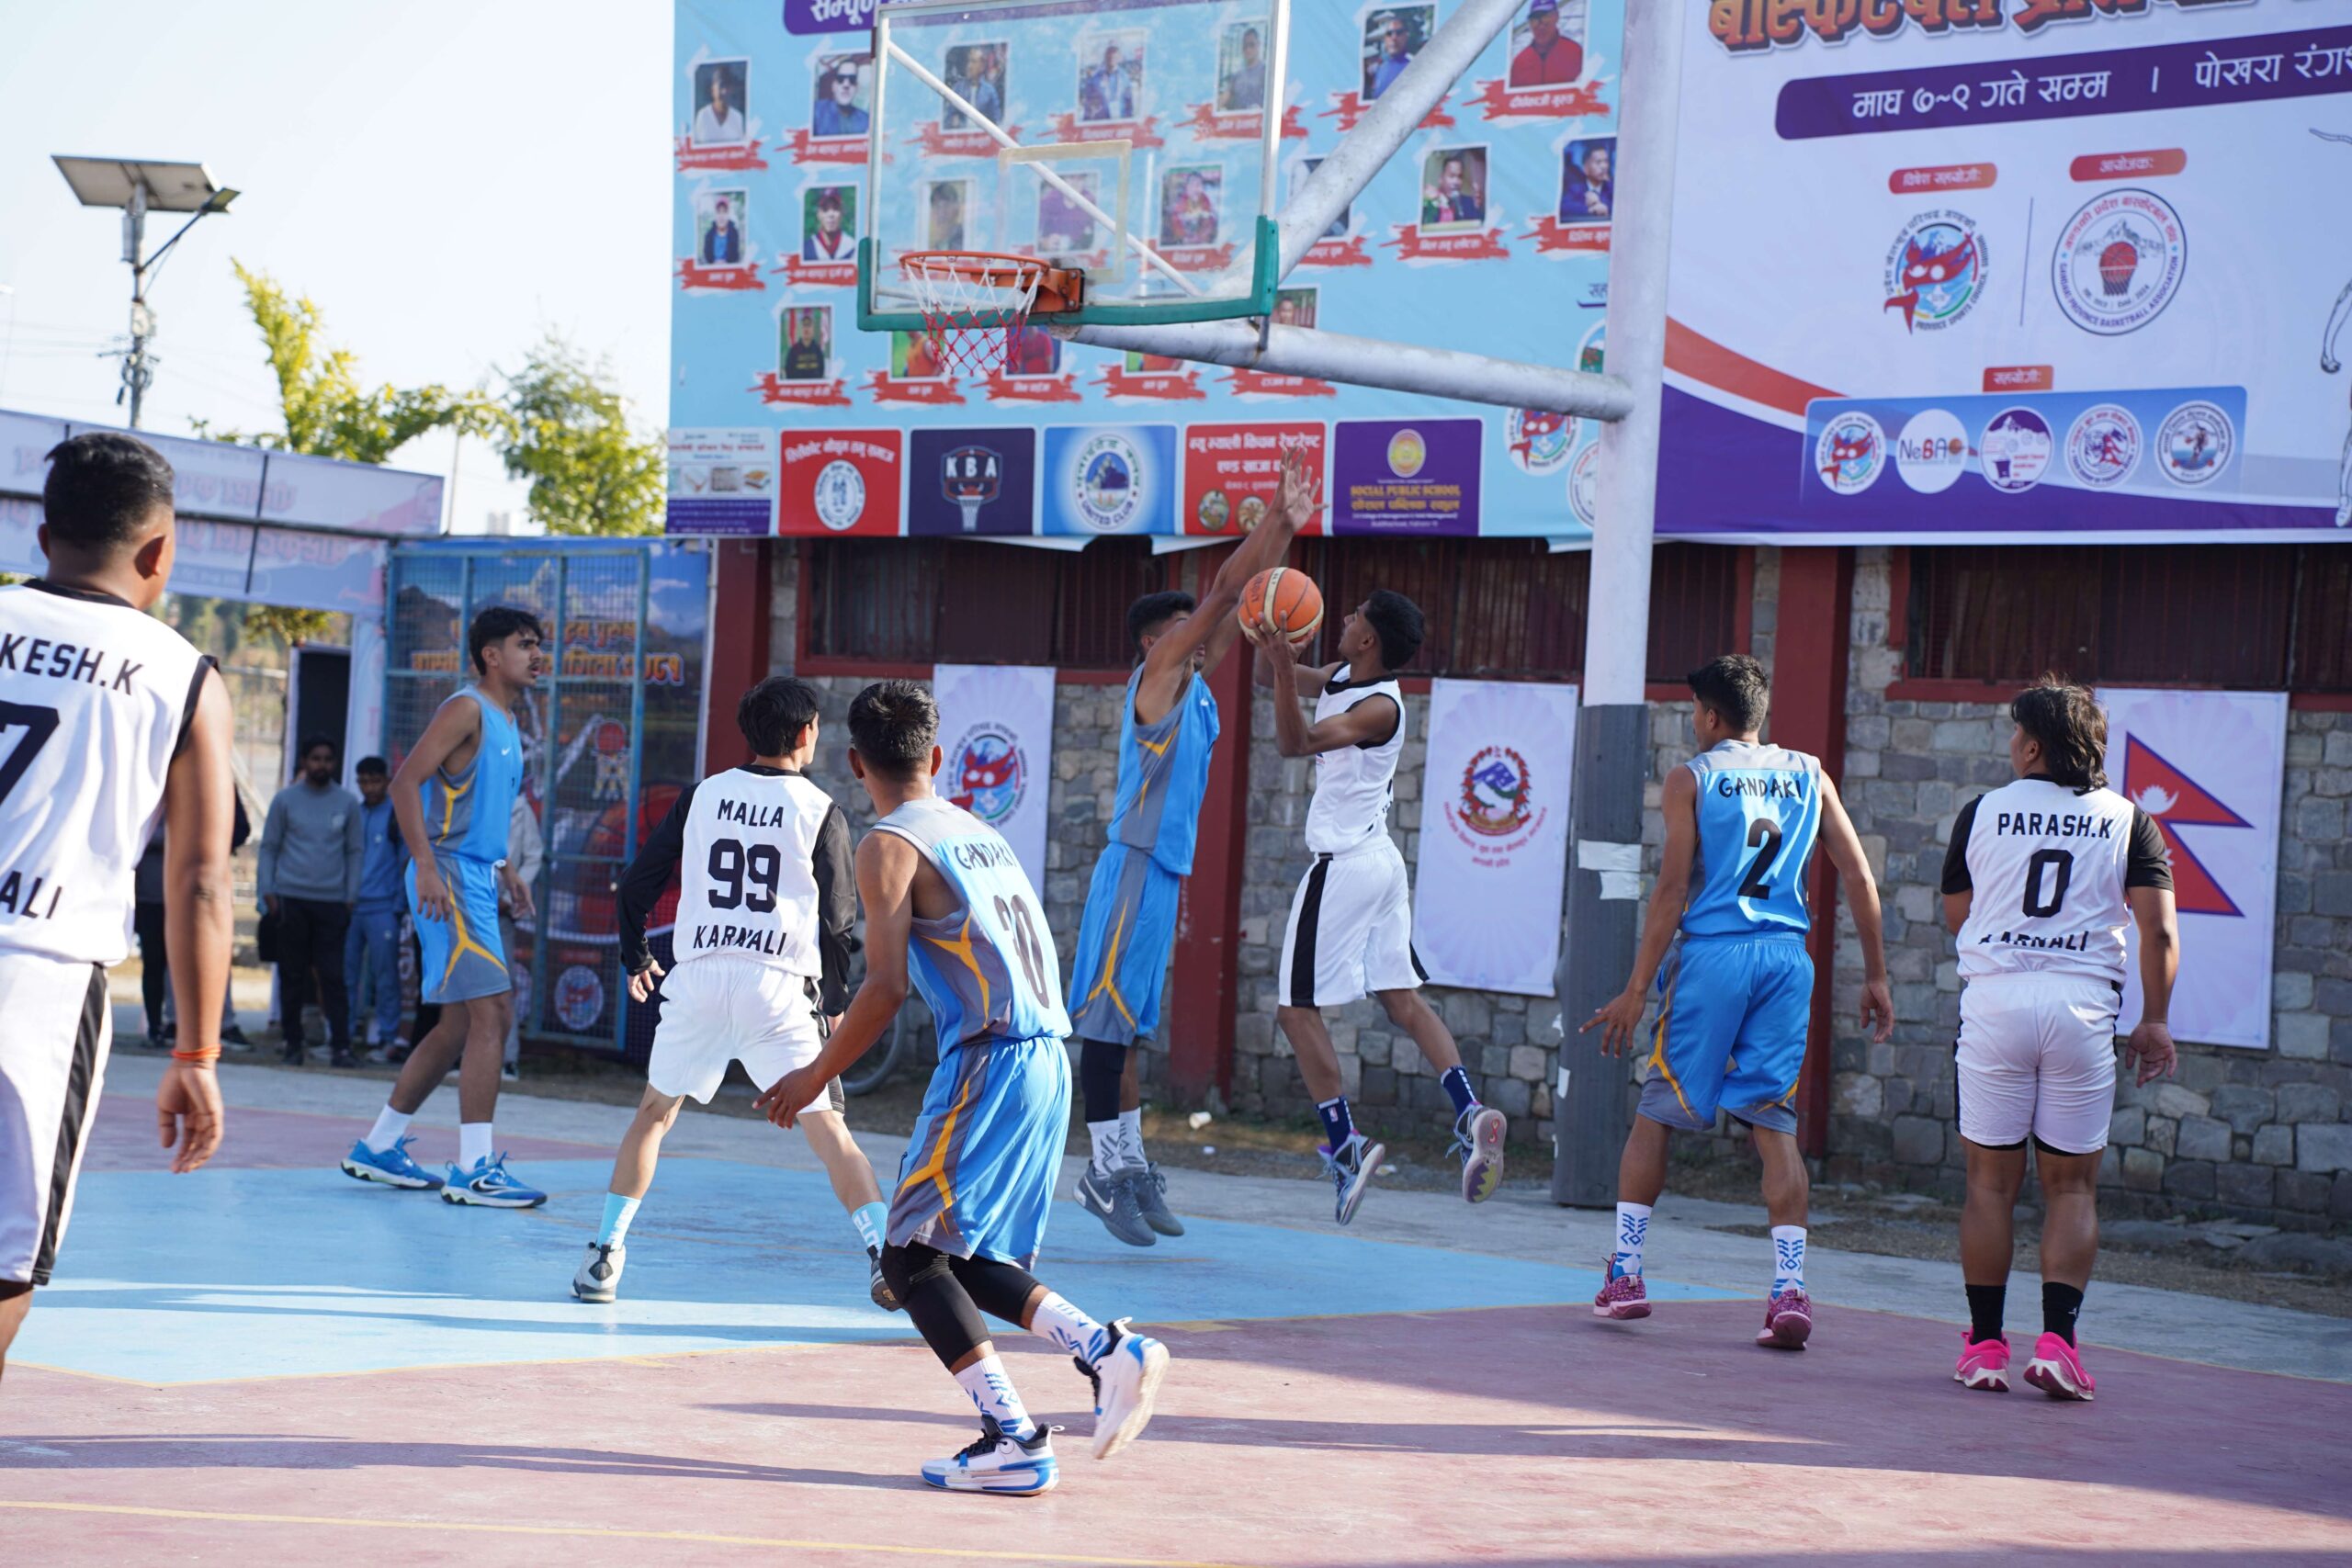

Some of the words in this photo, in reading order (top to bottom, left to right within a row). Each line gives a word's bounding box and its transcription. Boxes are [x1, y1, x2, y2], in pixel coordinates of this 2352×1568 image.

[1852, 89, 1905, 118] माघ
[1980, 70, 2029, 107] गते
[2037, 70, 2111, 103] सम्म
[2195, 51, 2285, 88] पोखरा
[2099, 308, 2148, 328] BASKETBALL
[2149, 255, 2178, 310] ASSOCIATION
[945, 456, 998, 478] KBA
[1386, 485, 1420, 497] PUBLIC
[1422, 485, 1461, 497] SCHOOL
[1081, 501, 1111, 525] UNITED
[1113, 501, 1134, 524] CLUB
[0, 700, 60, 804] 7
[1718, 777, 1802, 798] GANDAKI
[718, 798, 784, 828] MALLA
[1997, 812, 2114, 839] PARASH.K
[1736, 818, 1782, 900] 2
[707, 838, 781, 913] 99
[2022, 849, 2075, 918] 0
[693, 925, 787, 956] KARNALI
